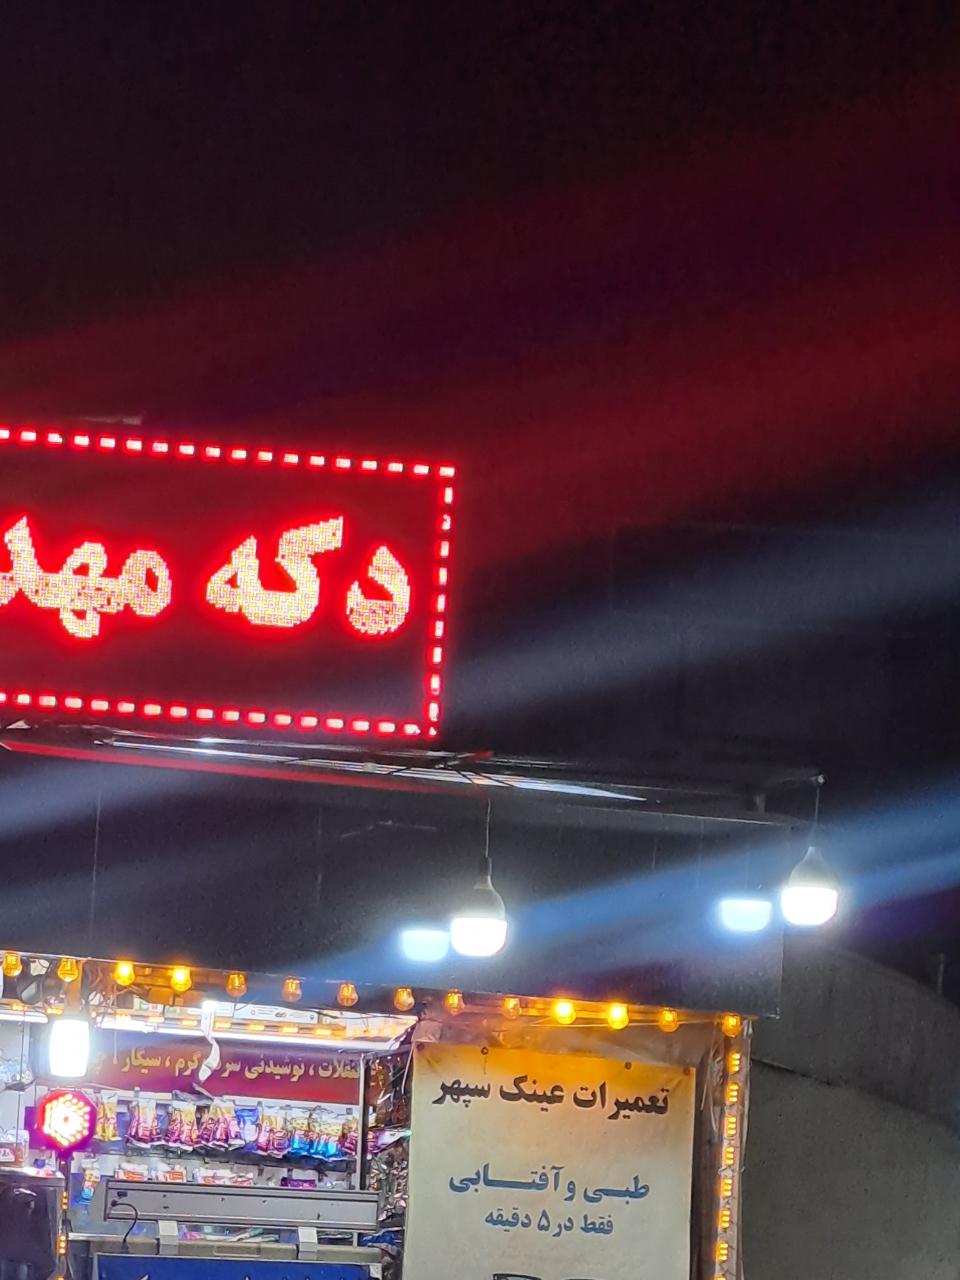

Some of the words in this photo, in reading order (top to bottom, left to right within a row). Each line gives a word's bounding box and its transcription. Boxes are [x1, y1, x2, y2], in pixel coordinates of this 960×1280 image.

[205, 515, 411, 635] دکه
[244, 1053, 306, 1082] نوشیدنی
[431, 1076, 491, 1110] سپهر
[498, 1074, 565, 1113] عینک
[572, 1080, 671, 1121] تعمیرات
[448, 1162, 566, 1194] آفتابی
[583, 1174, 651, 1205] طبی
[484, 1206, 533, 1233] دقیقه
[536, 1208, 551, 1232] ۵
[552, 1215, 575, 1238] در
[580, 1212, 614, 1236] فقط
